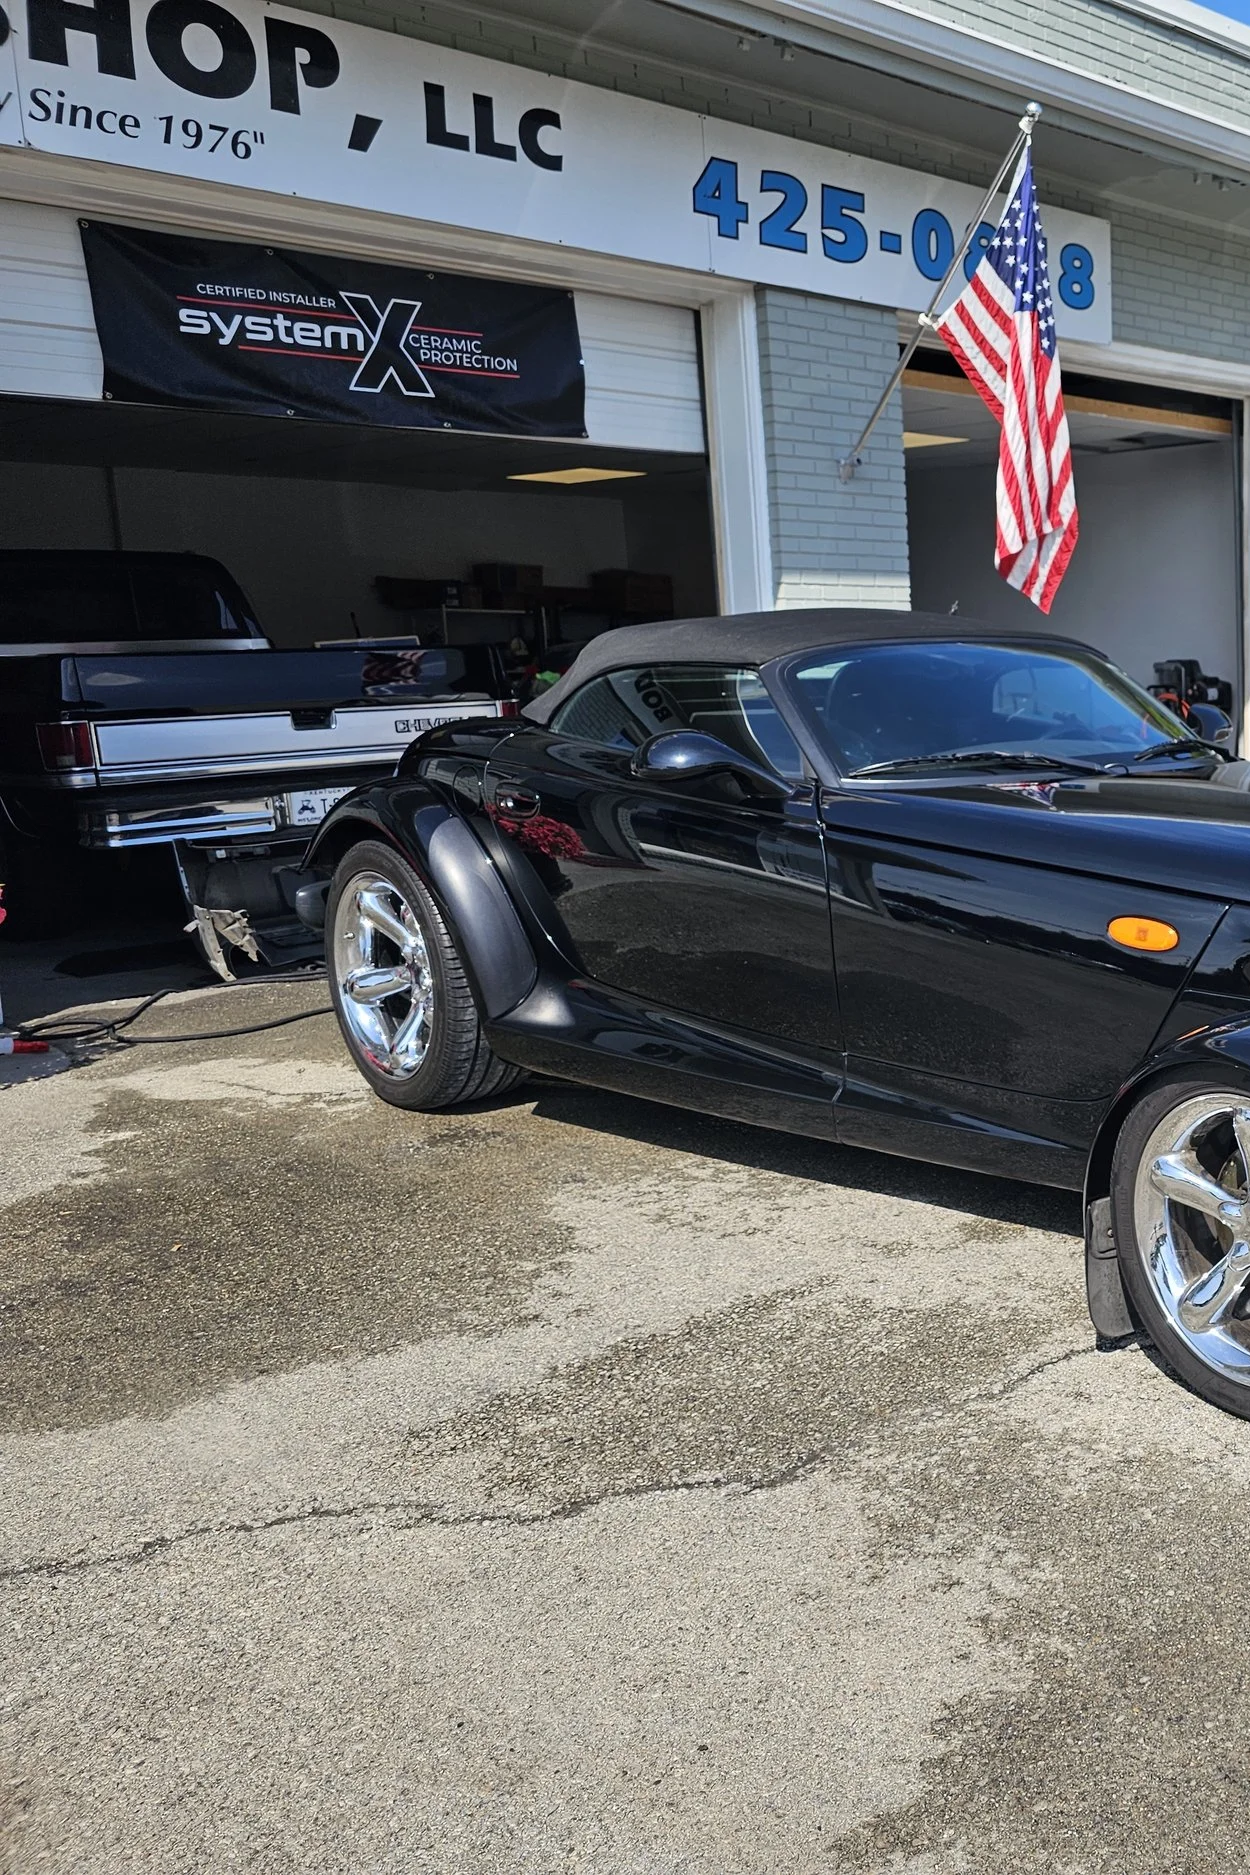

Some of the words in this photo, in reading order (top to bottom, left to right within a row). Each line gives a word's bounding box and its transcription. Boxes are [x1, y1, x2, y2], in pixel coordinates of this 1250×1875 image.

[0, 0, 383, 153] HOP,
[424, 81, 564, 172] LLC
[27, 88, 141, 139] Since
[158, 115, 266, 160] 1976"
[693, 157, 1095, 311] 425-088
[196, 283, 267, 300] CERTIFIED
[269, 291, 337, 309] INSTALLER
[408, 333, 482, 354] CERAMIC
[420, 349, 518, 372] PROTECTION
